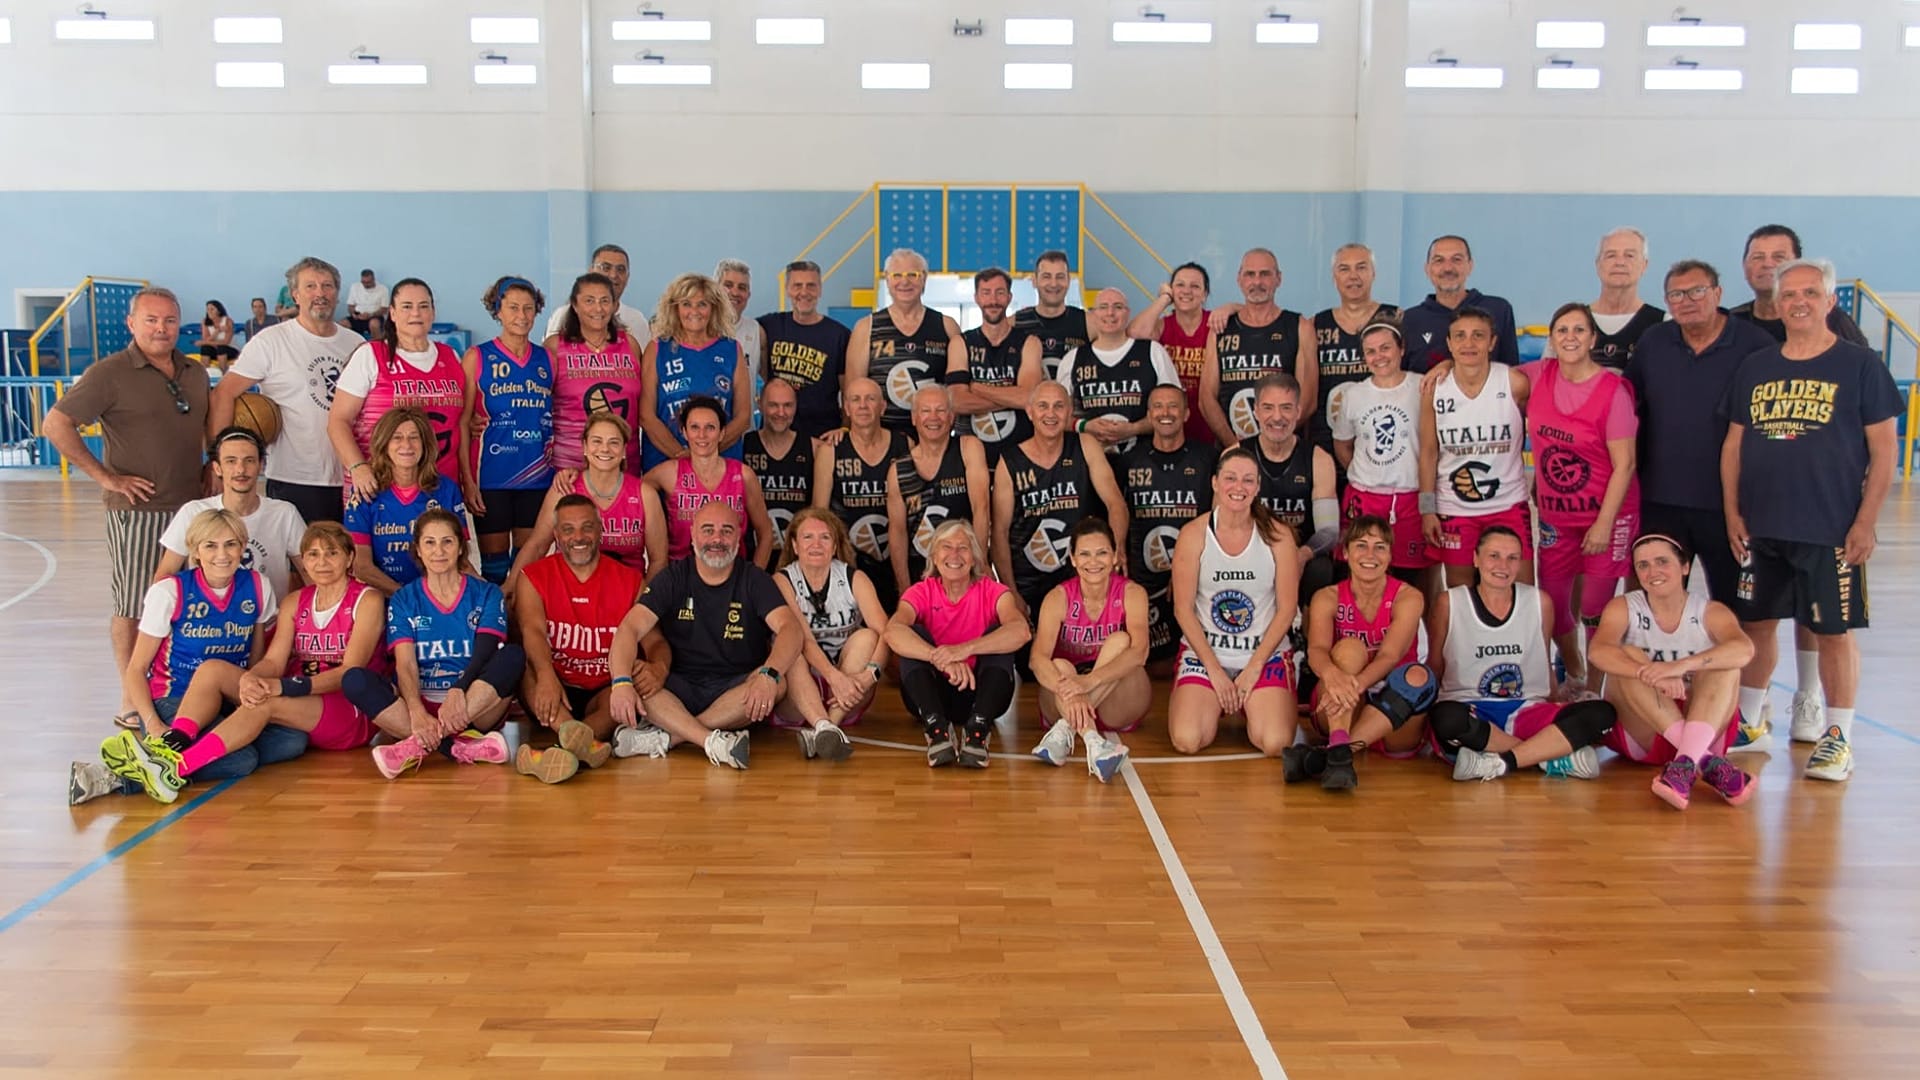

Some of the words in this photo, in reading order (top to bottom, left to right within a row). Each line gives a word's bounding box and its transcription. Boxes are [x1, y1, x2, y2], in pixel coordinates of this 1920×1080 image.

[771, 341, 829, 368] GOLDEN
[872, 340, 896, 359] 74
[1319, 348, 1363, 363] ITAL
[567, 354, 634, 369] ITALIA
[665, 358, 684, 376] 15
[770, 356, 824, 381] PLAYERS
[1222, 354, 1283, 370] ITALIA
[491, 362, 511, 379] 10
[971, 365, 1015, 380] ITALIA
[393, 380, 462, 395] ITALIA
[490, 382, 524, 397] Golden
[1080, 380, 1143, 397] ITALIA
[1751, 379, 1839, 403] GOLDEN
[511, 398, 546, 408] ITALIA
[1436, 398, 1456, 414] 92
[1750, 399, 1835, 425] PLAYERS
[1439, 424, 1512, 445] ITALIA
[1764, 421, 1805, 431] BASKETBALL
[836, 458, 863, 478] 558
[758, 475, 807, 489] TALIA
[1128, 468, 1152, 487] 552
[842, 480, 889, 495] ITALI
[940, 485, 967, 497] PLAYERS
[1134, 490, 1197, 505] ITALIA
[1540, 495, 1602, 513] ITALIA
[374, 522, 407, 535] Golden
[388, 541, 410, 553] ITA
[1071, 602, 1080, 619] 2
[1812, 602, 1821, 623] 1
[181, 621, 222, 638] Golden
[205, 643, 245, 655] ITALIA
[296, 632, 347, 653] TALI
[416, 640, 472, 661] TALI
